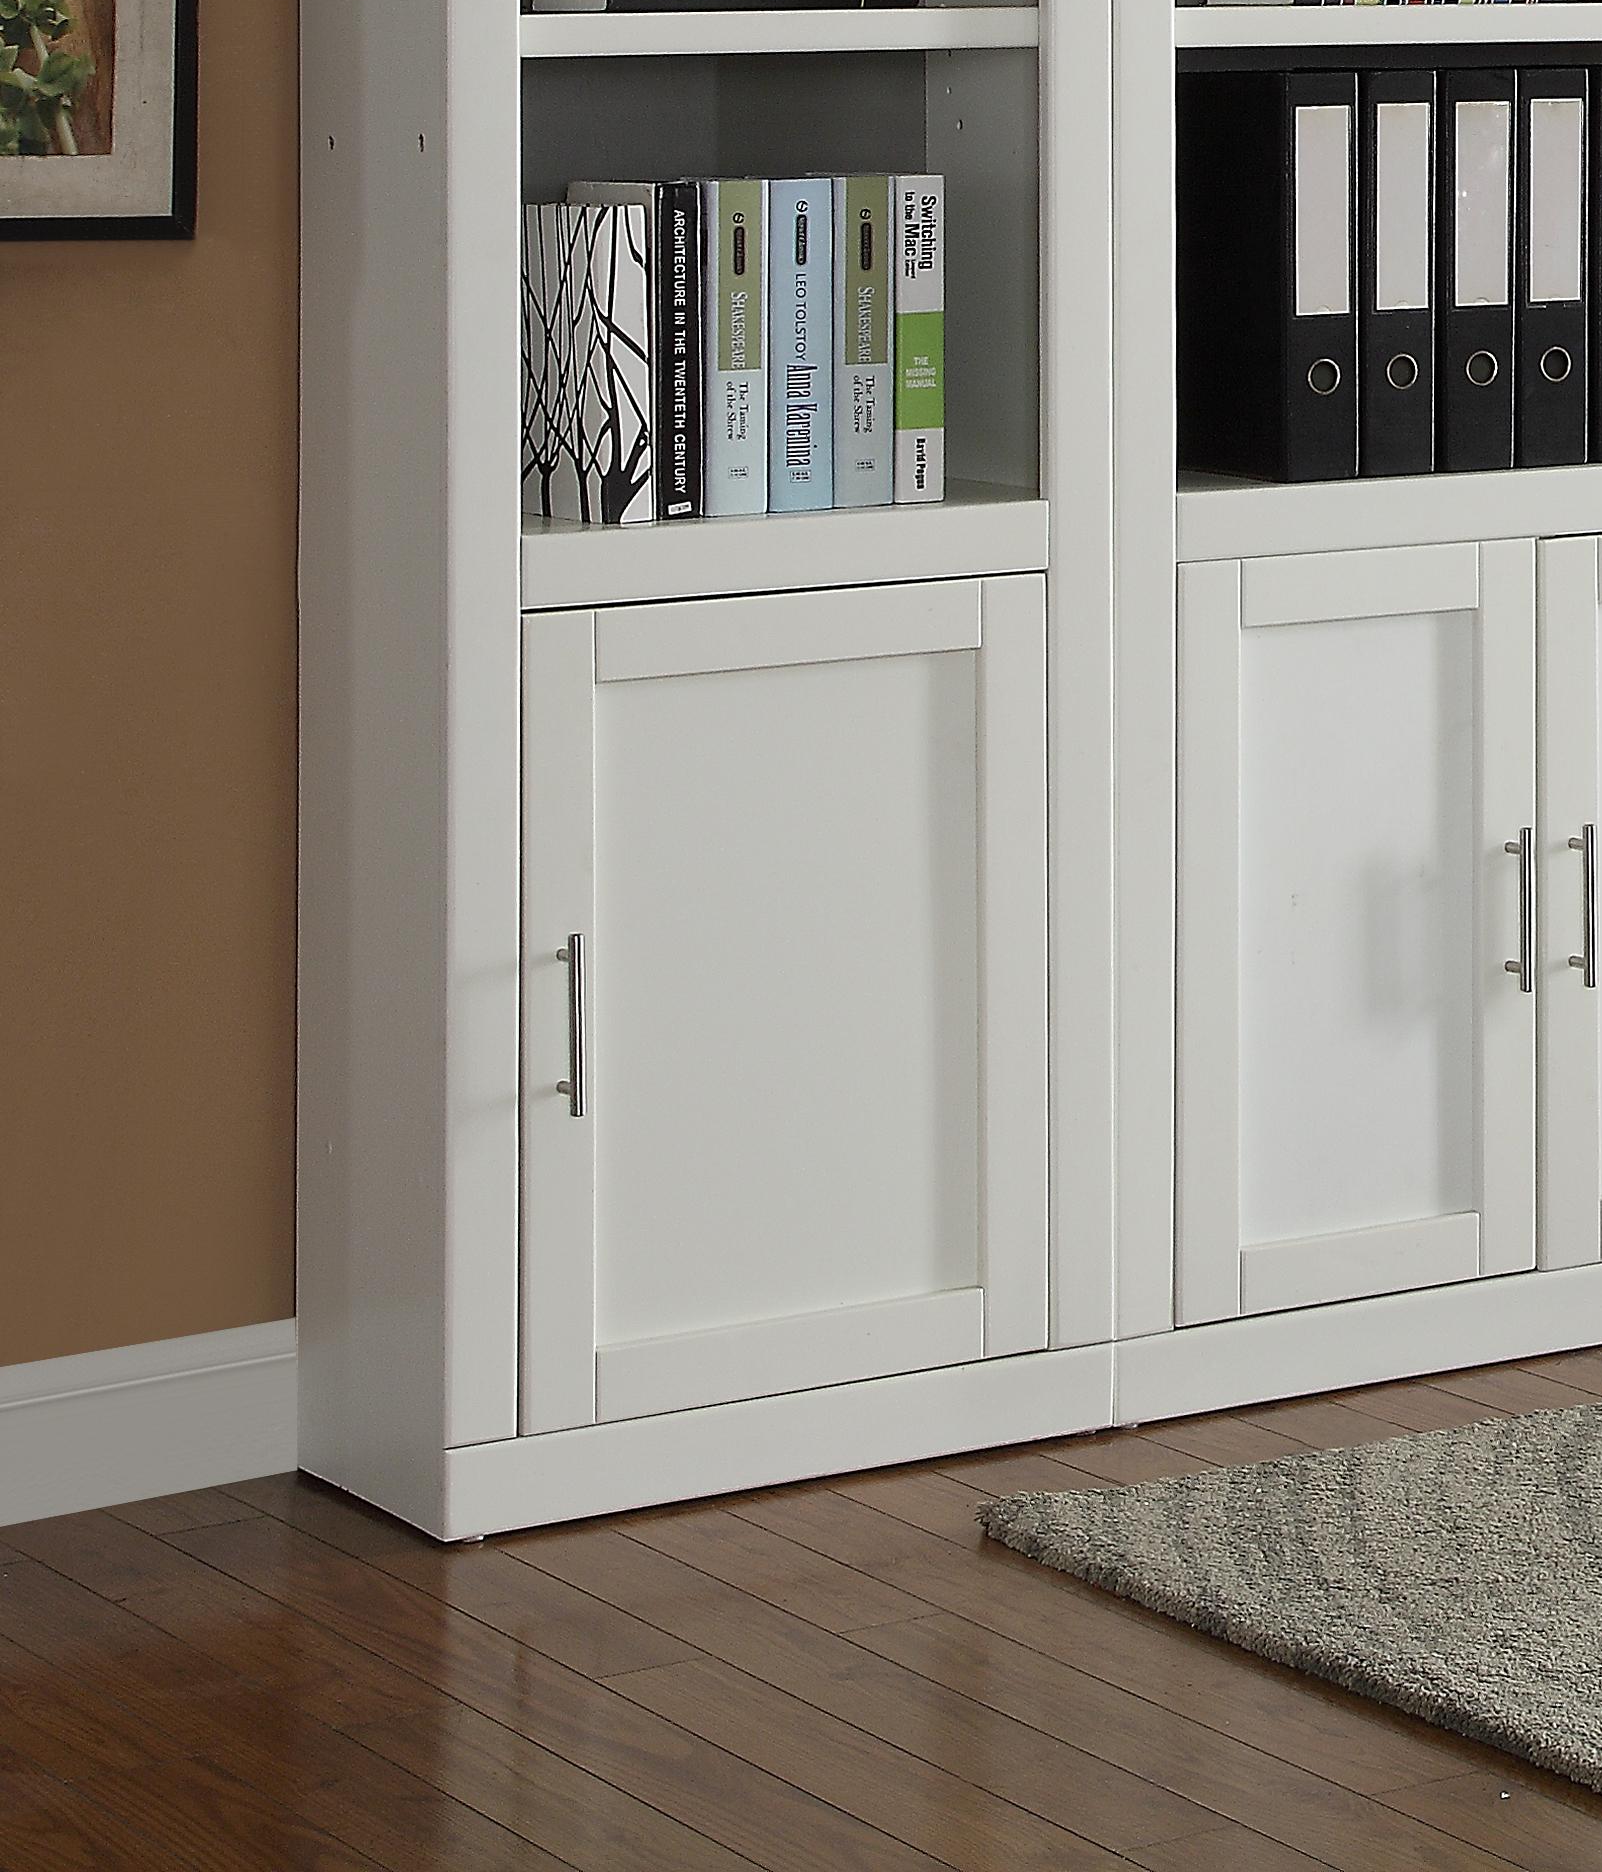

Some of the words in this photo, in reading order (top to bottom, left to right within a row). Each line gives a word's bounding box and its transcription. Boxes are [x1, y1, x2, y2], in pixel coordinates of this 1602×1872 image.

[905, 191, 914, 204] to
[905, 206, 914, 220] the
[905, 222, 919, 256] Mac
[919, 194, 936, 270] Switching
[674, 209, 686, 306] ARCHITECTURE
[795, 273, 806, 298] LEO
[674, 312, 686, 325] IN
[732, 292, 747, 369] SHAKESPEARE
[795, 301, 806, 361] TOLSTOY
[858, 286, 874, 363] SHAKESPEARE
[674, 330, 686, 356] THE
[674, 360, 686, 427] TWENTETH
[726, 381, 734, 392] of
[740, 381, 749, 401] The
[786, 364, 817, 399] Anna
[852, 388, 860, 403] the
[865, 375, 874, 395] The
[726, 394, 734, 409] the
[865, 398, 874, 433] Taming
[726, 412, 734, 440] Shrew
[740, 404, 749, 440] Taming
[852, 406, 860, 433] Shrew
[786, 404, 817, 468] Karenina
[674, 434, 686, 493] CENTURY
